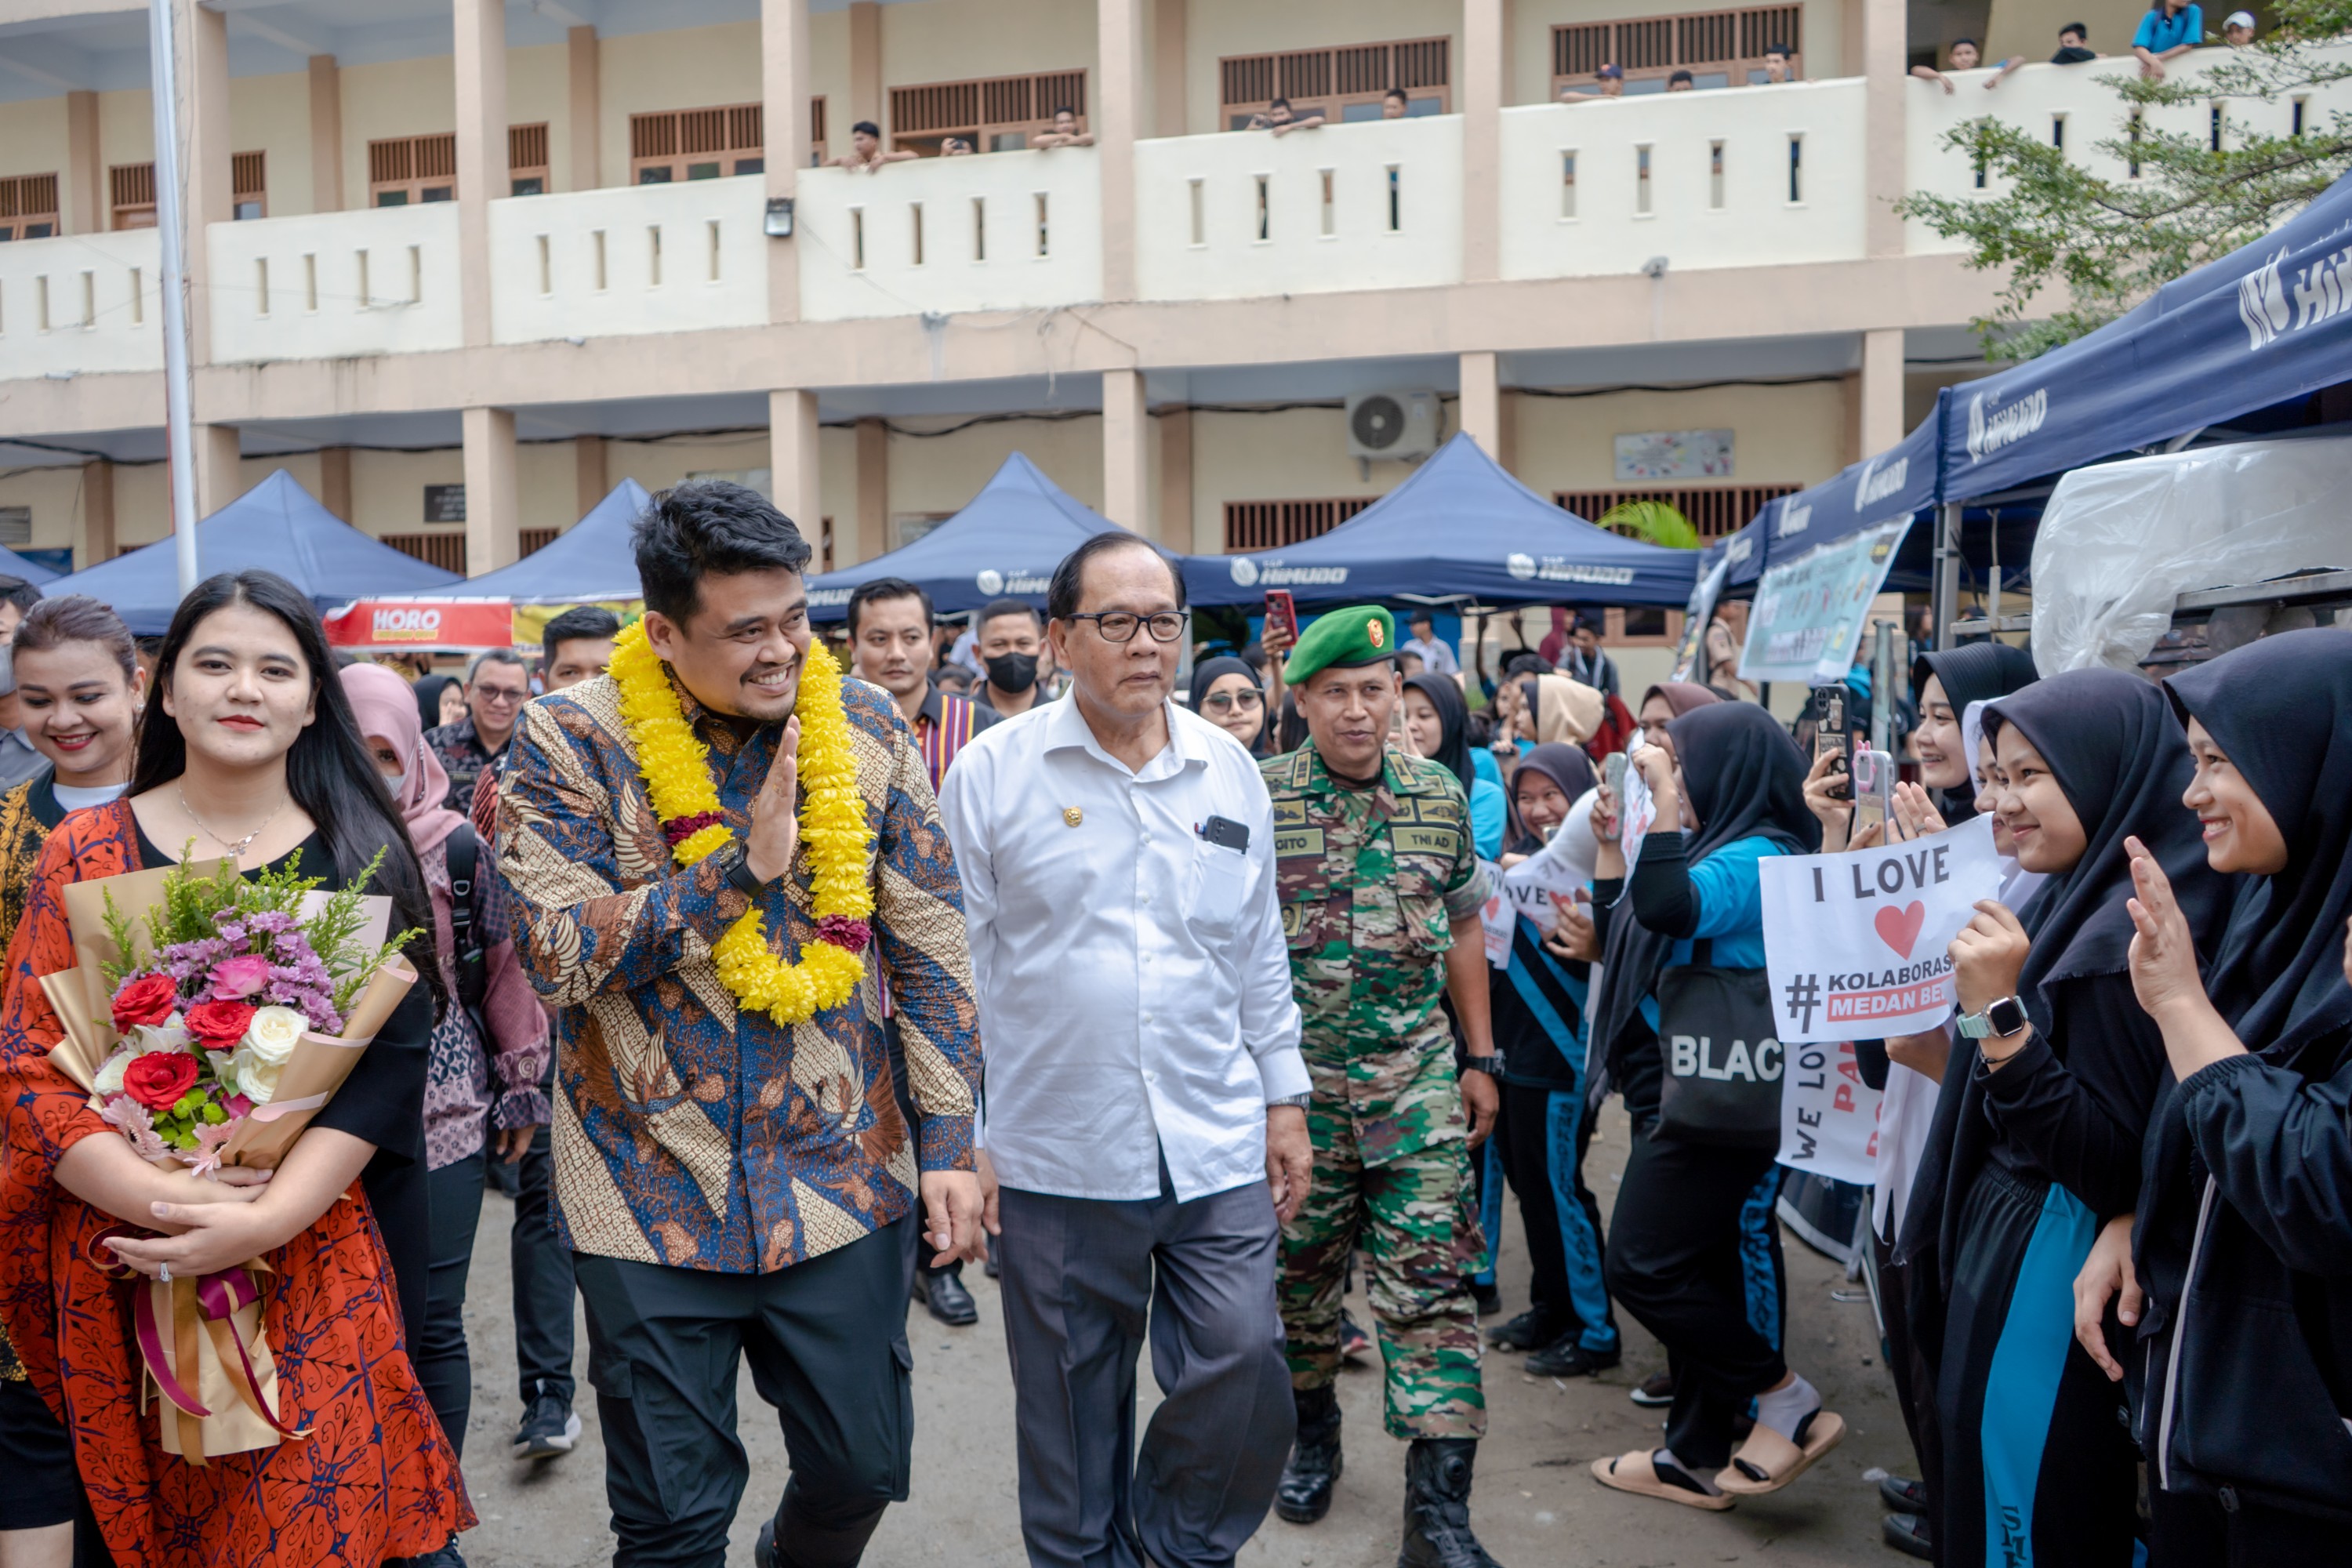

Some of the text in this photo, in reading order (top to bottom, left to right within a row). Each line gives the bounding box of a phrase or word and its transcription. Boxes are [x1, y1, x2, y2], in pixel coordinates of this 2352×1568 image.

[1411, 834, 1450, 848] TNI AD
[1812, 844, 1950, 902] I LOVE
[1828, 953, 1955, 992] KOLABORAS
[1831, 990, 1916, 1017] MEDAN
[1671, 1035, 1784, 1083] BLAC
[1791, 1106, 1822, 1160] WE
